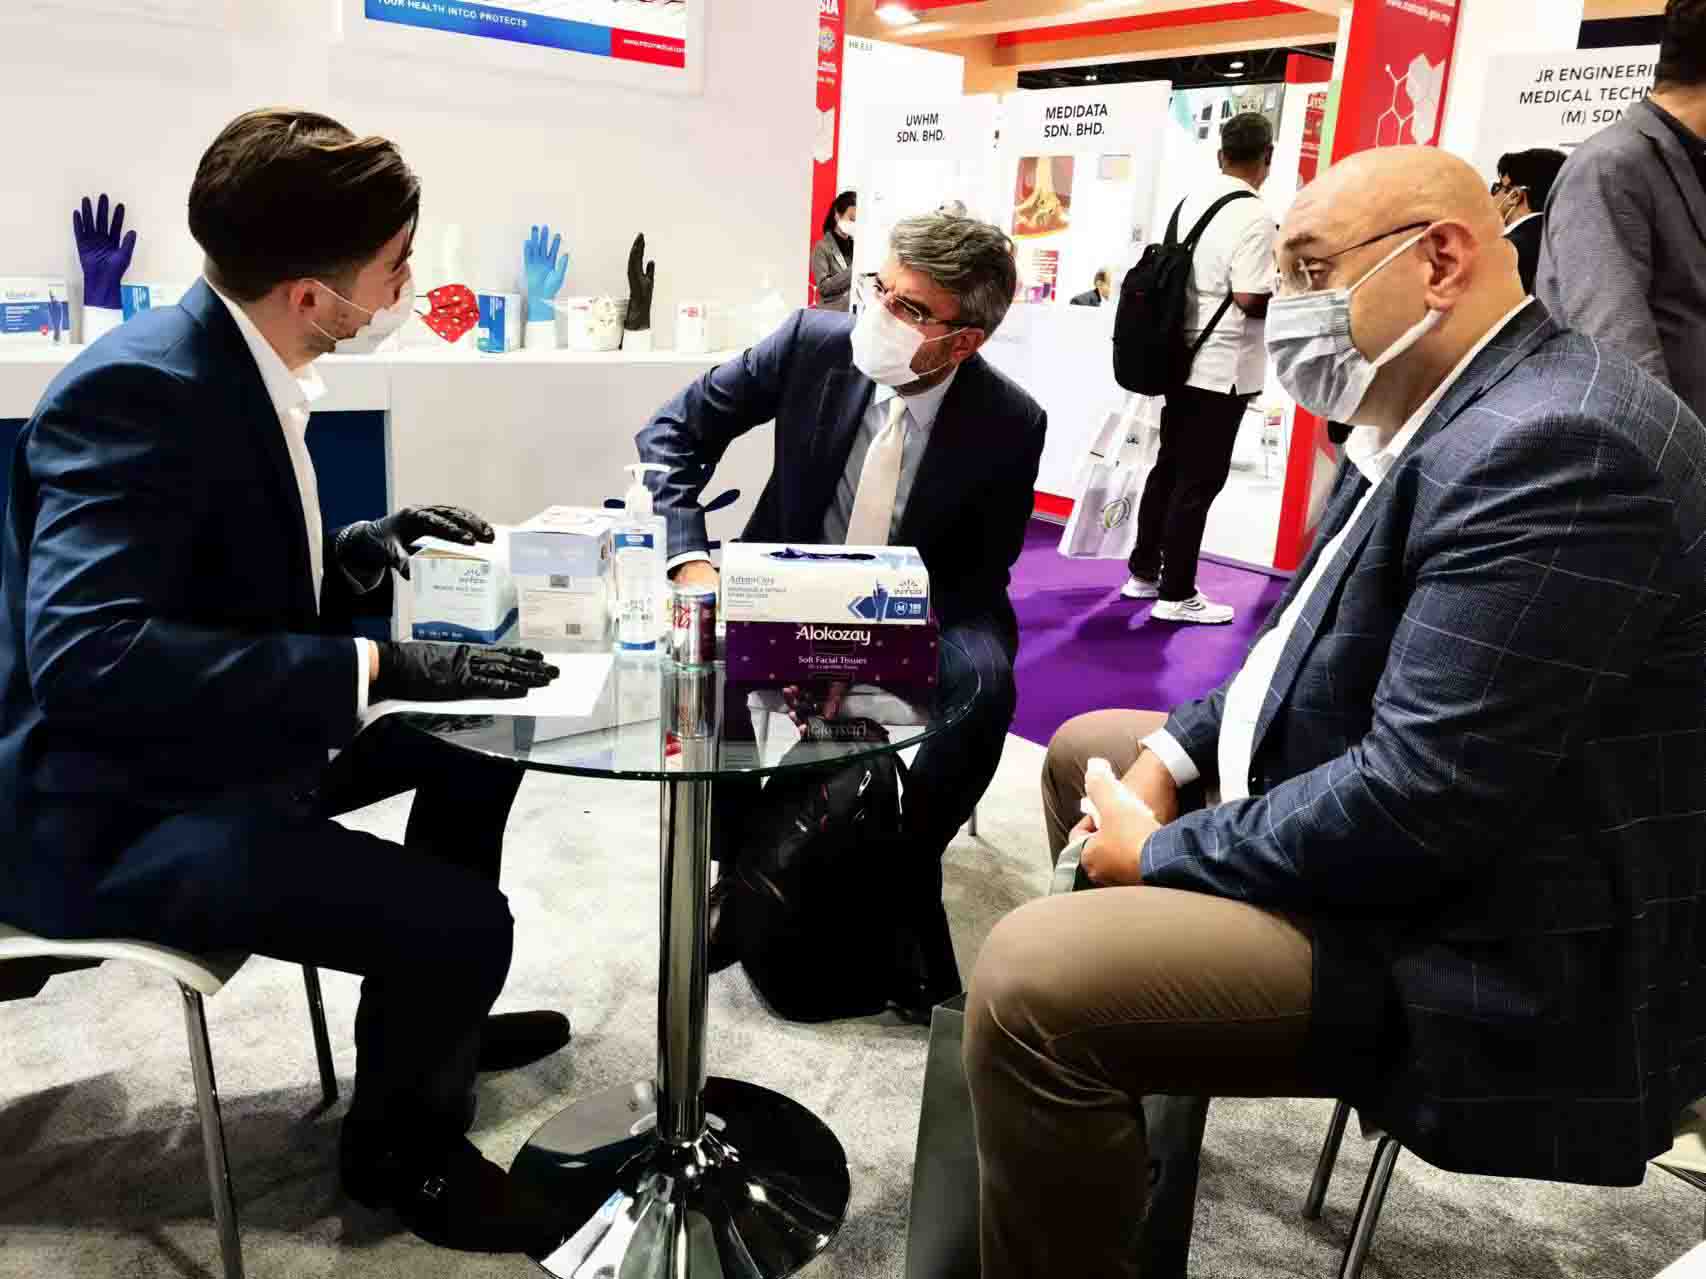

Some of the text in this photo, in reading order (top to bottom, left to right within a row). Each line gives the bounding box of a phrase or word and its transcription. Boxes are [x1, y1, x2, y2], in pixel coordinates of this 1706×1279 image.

[407, 0, 446, 14] HEALTH
[447, 7, 477, 18] INTCO
[480, 12, 528, 28] PROTECTS
[1535, 63, 1656, 82] JR ENGINEERI
[1519, 89, 1593, 104] MEDICAL
[906, 112, 939, 127] UWHM
[1045, 103, 1108, 120] MEDIDATA
[1560, 110, 1586, 126] (M)
[896, 129, 945, 143] SDN. BHD.
[1044, 122, 1105, 138] SDN. BHD.
[794, 625, 871, 646] Alokozay
[798, 655, 868, 664] Soft Facial Tissues
